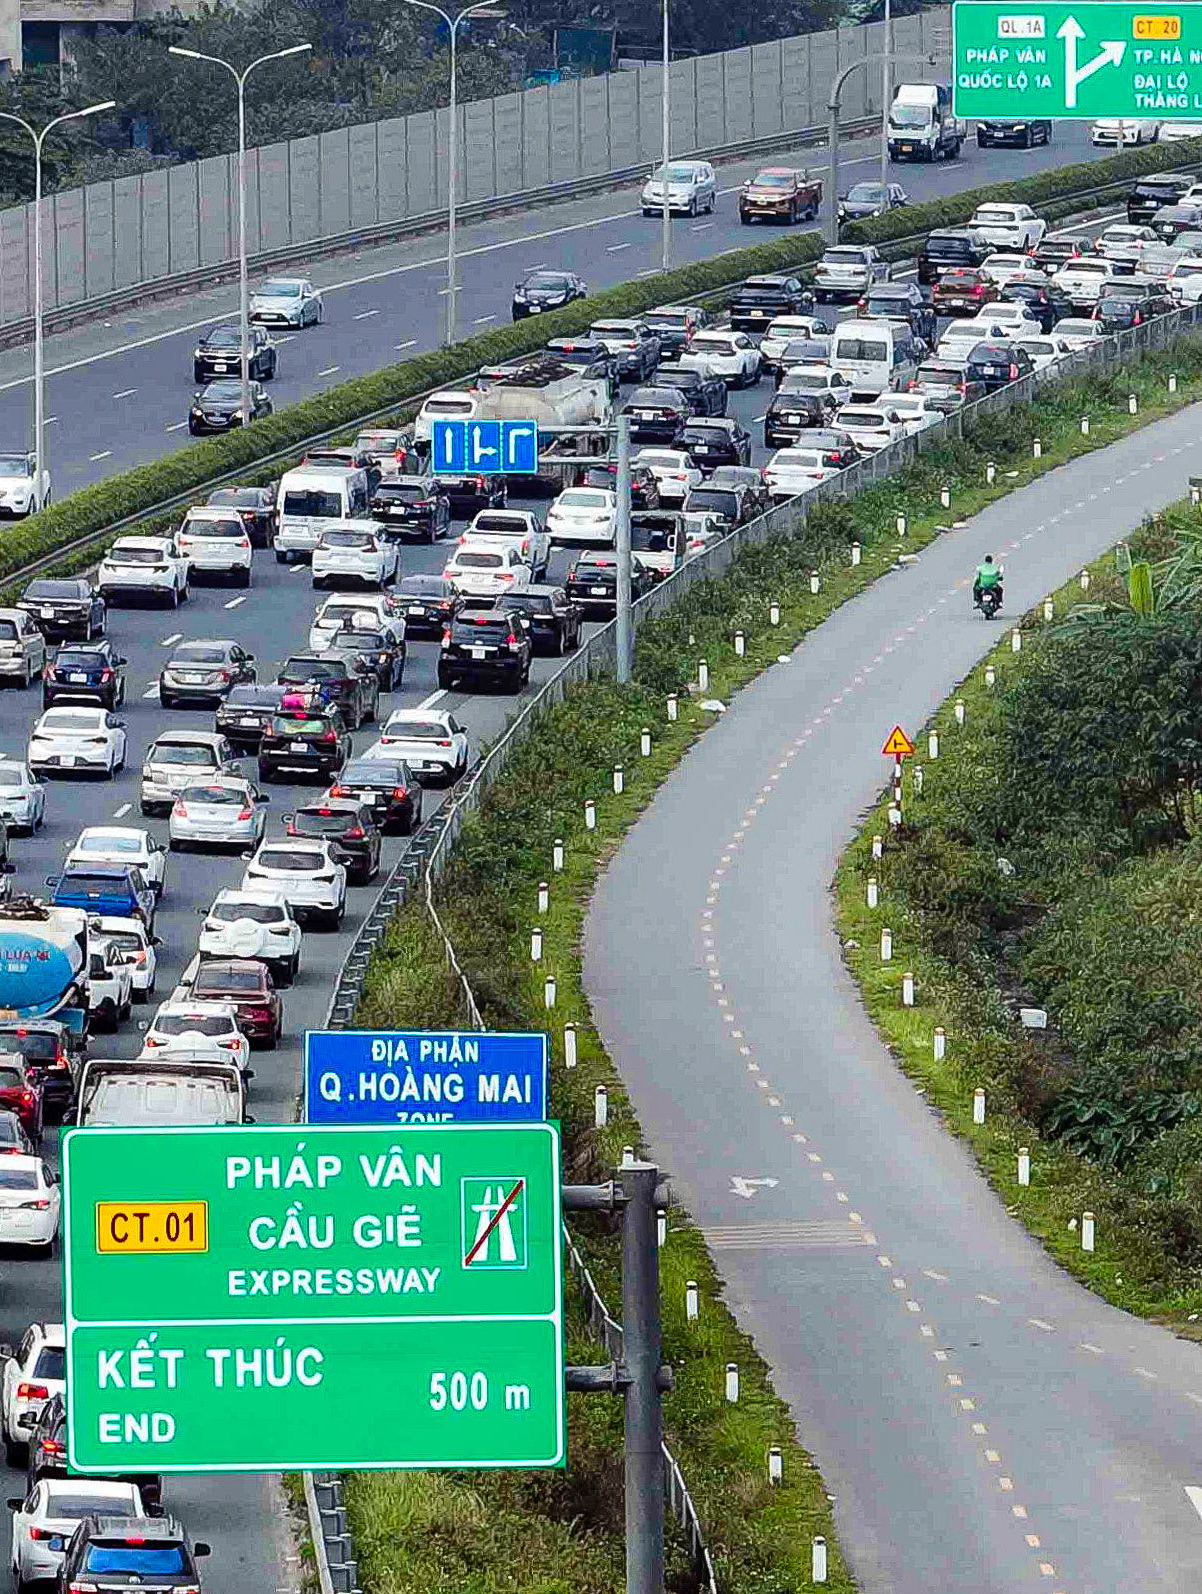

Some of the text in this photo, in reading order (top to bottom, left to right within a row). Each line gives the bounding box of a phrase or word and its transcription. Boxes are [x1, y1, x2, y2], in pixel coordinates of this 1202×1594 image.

[1001, 20, 1042, 34] QL.1A
[966, 45, 1046, 63] PHÁP VÂN
[1134, 46, 1202, 64] TP.HÀ N
[958, 68, 1052, 93] QUỐC LỘ 1A
[1134, 71, 1188, 92] ĐẠI LỘ
[371, 1036, 478, 1068] ĐỊA PHẬN
[319, 1066, 531, 1103] Q.HOÀNG MAI
[226, 1142, 442, 1189] PHÁP VÂN
[110, 1211, 194, 1243] CT.01
[249, 1201, 422, 1249] CẦU GIẼ
[228, 1267, 441, 1296] EXPRESSWAY
[98, 1332, 324, 1389] KẾT THÚC
[429, 1371, 530, 1411] 500 m
[99, 1412, 176, 1443] END
